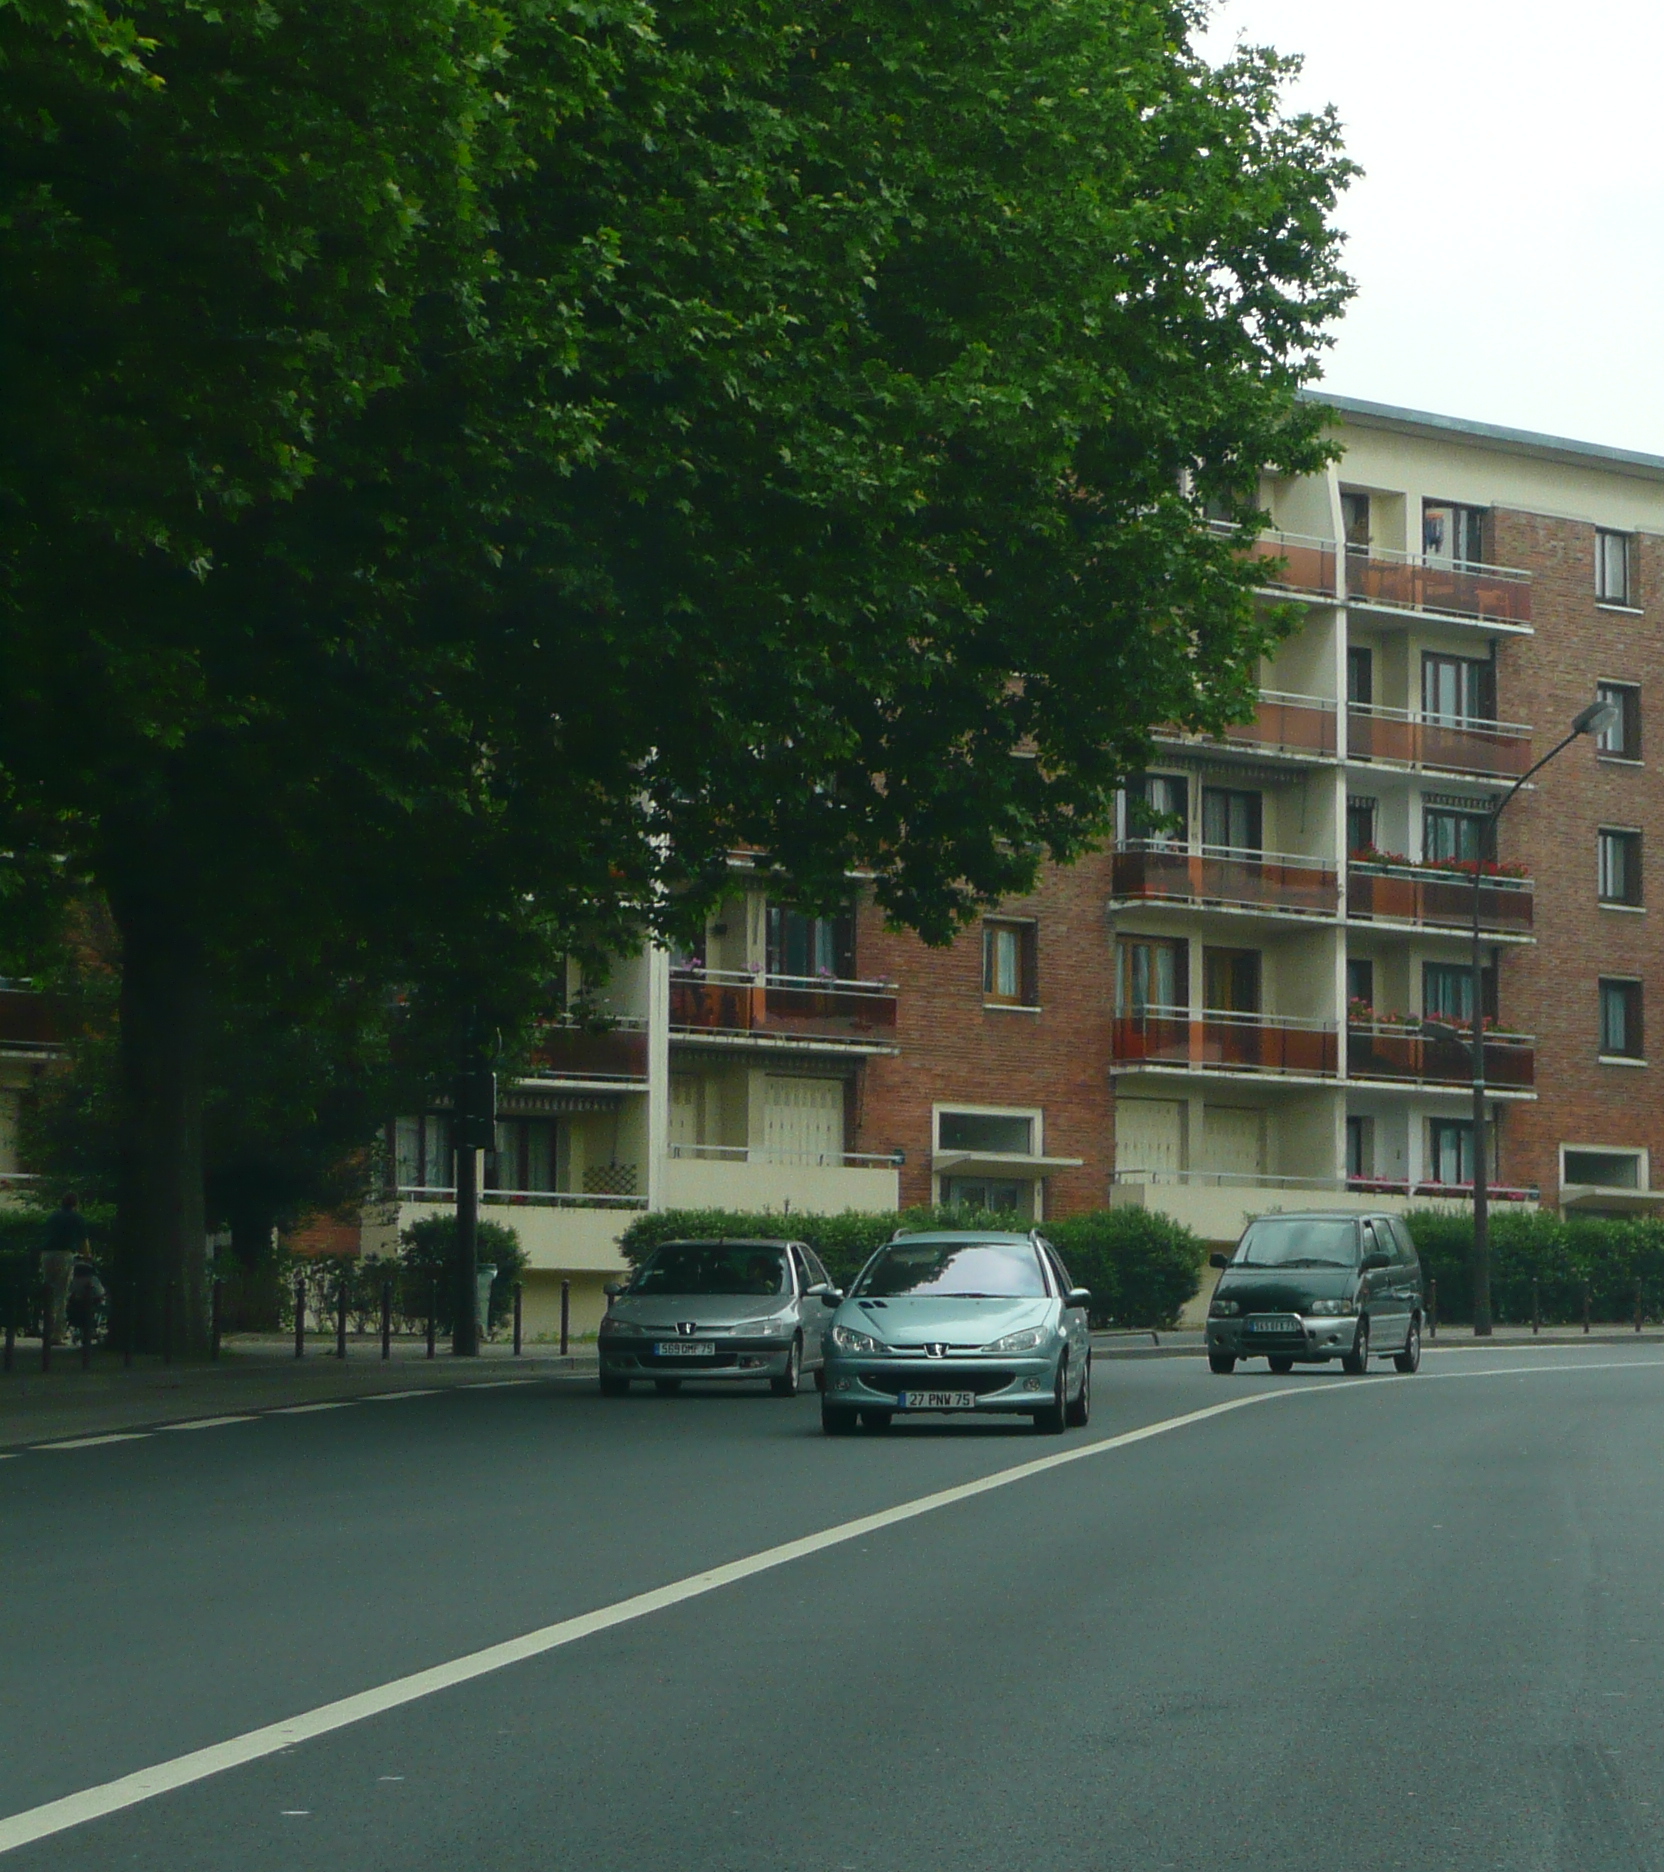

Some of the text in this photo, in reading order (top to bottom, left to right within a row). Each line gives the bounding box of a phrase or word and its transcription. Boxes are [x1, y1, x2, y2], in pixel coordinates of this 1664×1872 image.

[909, 1393, 970, 1406] 27 PNW 75
